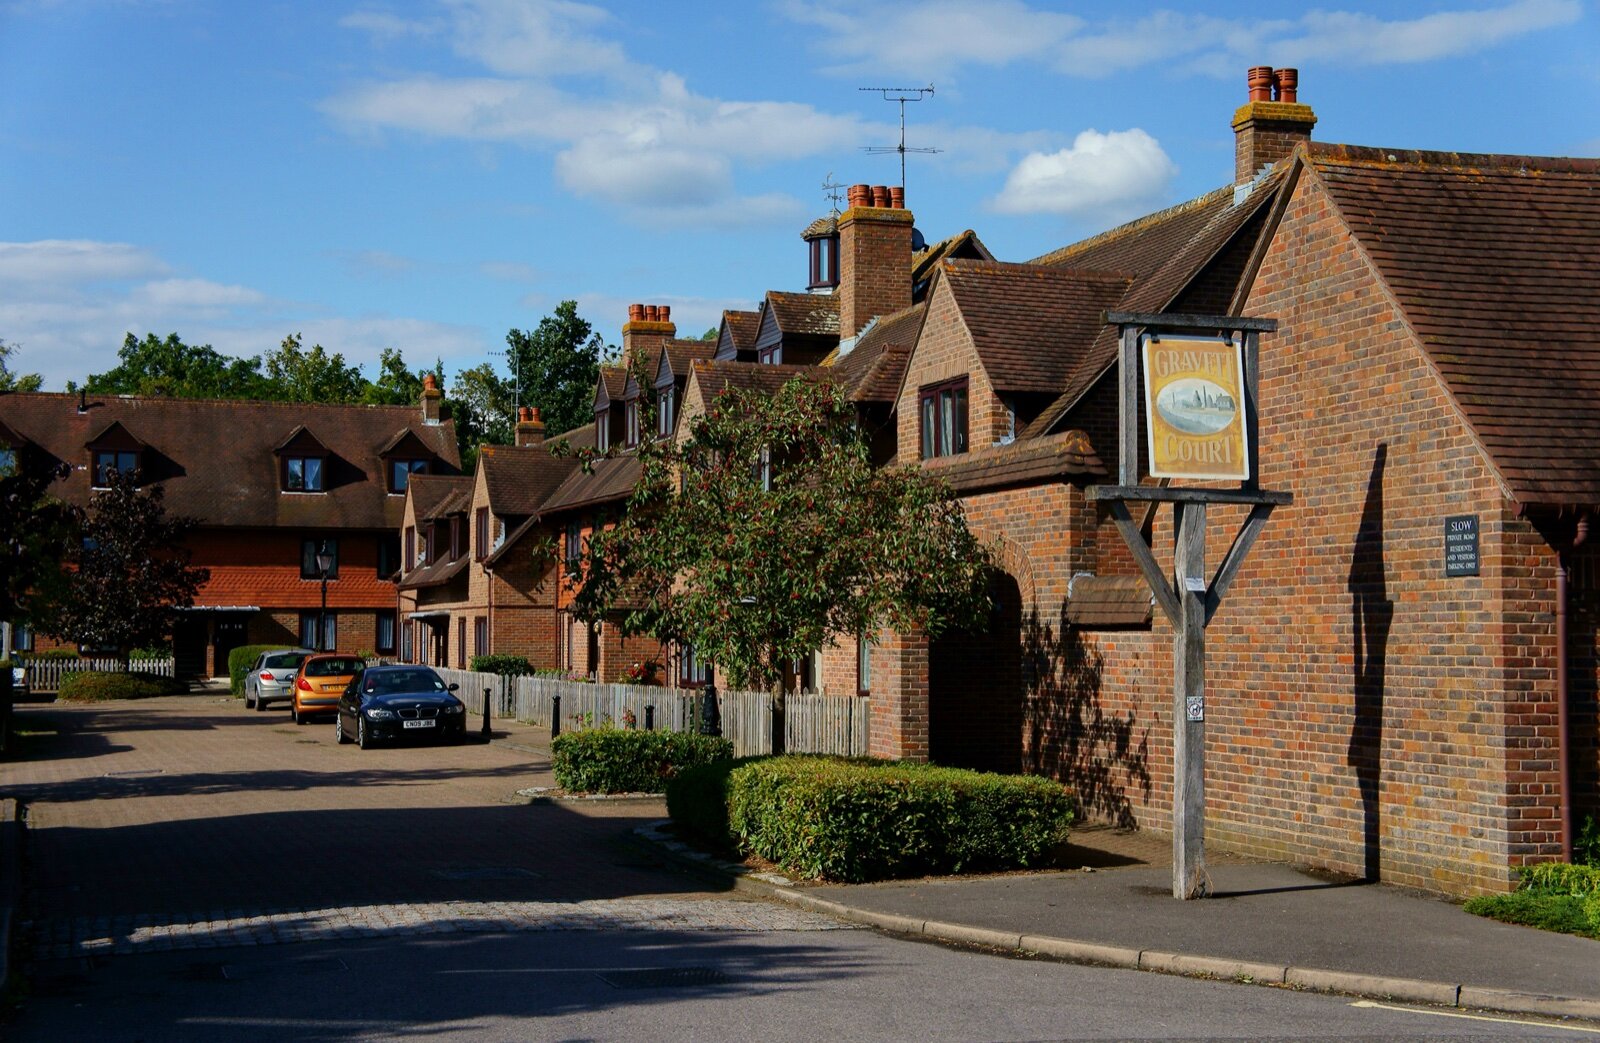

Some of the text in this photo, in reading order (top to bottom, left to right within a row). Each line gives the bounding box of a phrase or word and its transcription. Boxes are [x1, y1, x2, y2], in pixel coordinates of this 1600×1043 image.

[1154, 350, 1234, 384] GRAVETT
[1164, 433, 1233, 464] COURT
[1451, 520, 1472, 531] SLOW
[1450, 544, 1473, 552] RESIDENTS
[1447, 562, 1464, 570] PARKING
